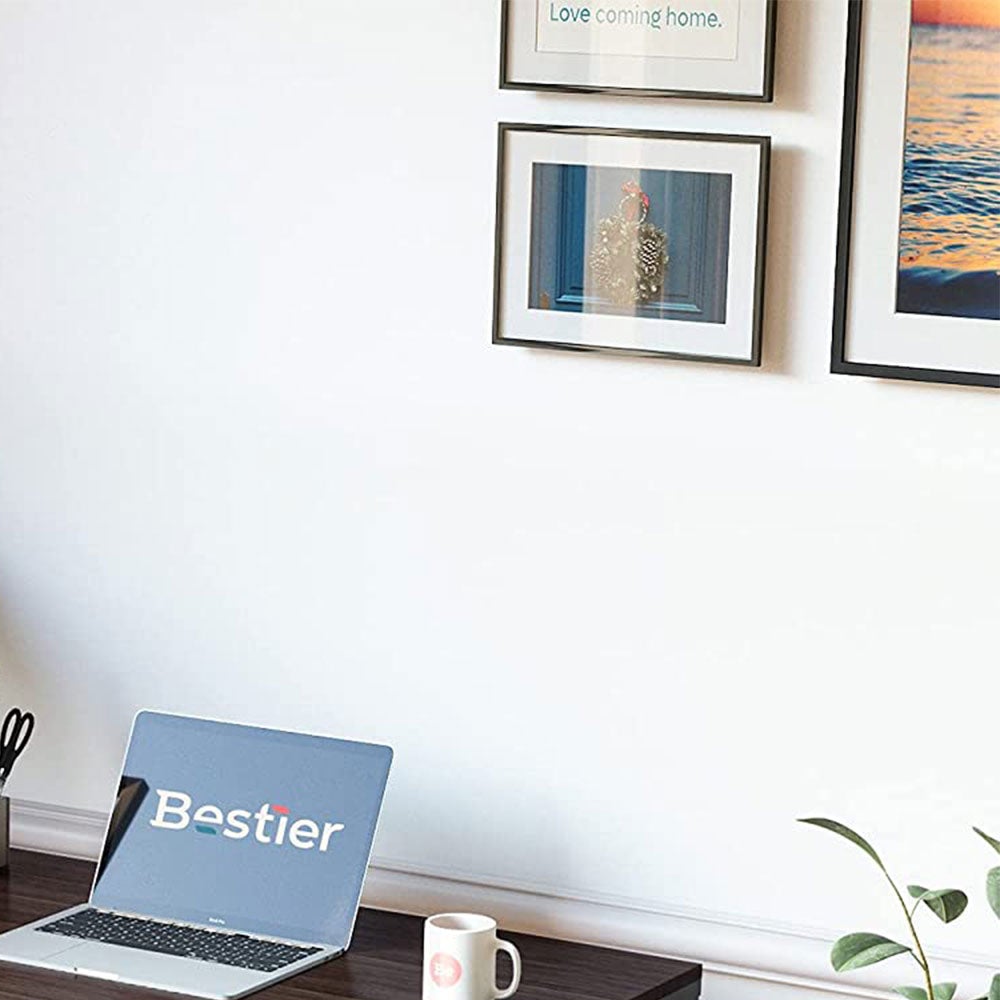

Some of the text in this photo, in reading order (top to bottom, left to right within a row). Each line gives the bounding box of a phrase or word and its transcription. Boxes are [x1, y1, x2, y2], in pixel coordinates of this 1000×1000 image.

[550, 3, 722, 29] Love coming home.
[150, 788, 345, 851] Bestier
